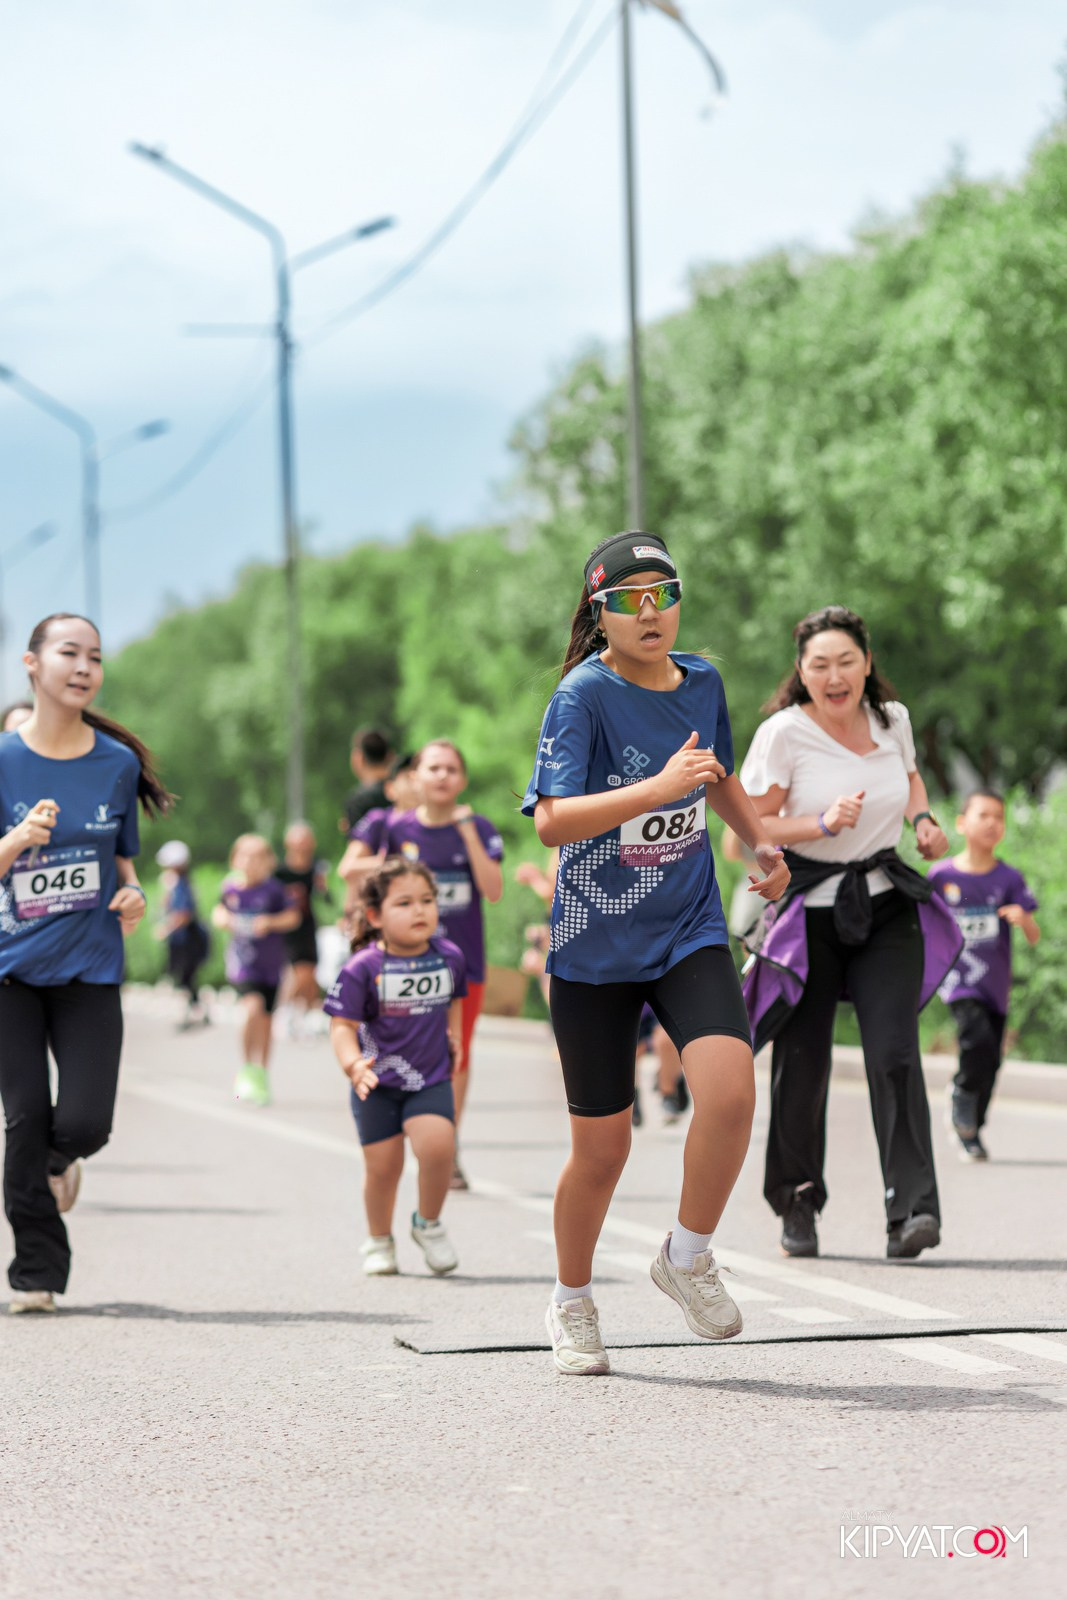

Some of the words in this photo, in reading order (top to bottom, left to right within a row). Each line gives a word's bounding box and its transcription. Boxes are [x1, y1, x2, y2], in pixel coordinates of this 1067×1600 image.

[545, 761, 561, 770] City
[642, 807, 697, 842] 082
[624, 846, 672, 855] БАЛАЛАР
[660, 853, 676, 863] 600
[31, 868, 85, 894] 046
[398, 976, 440, 997] 201
